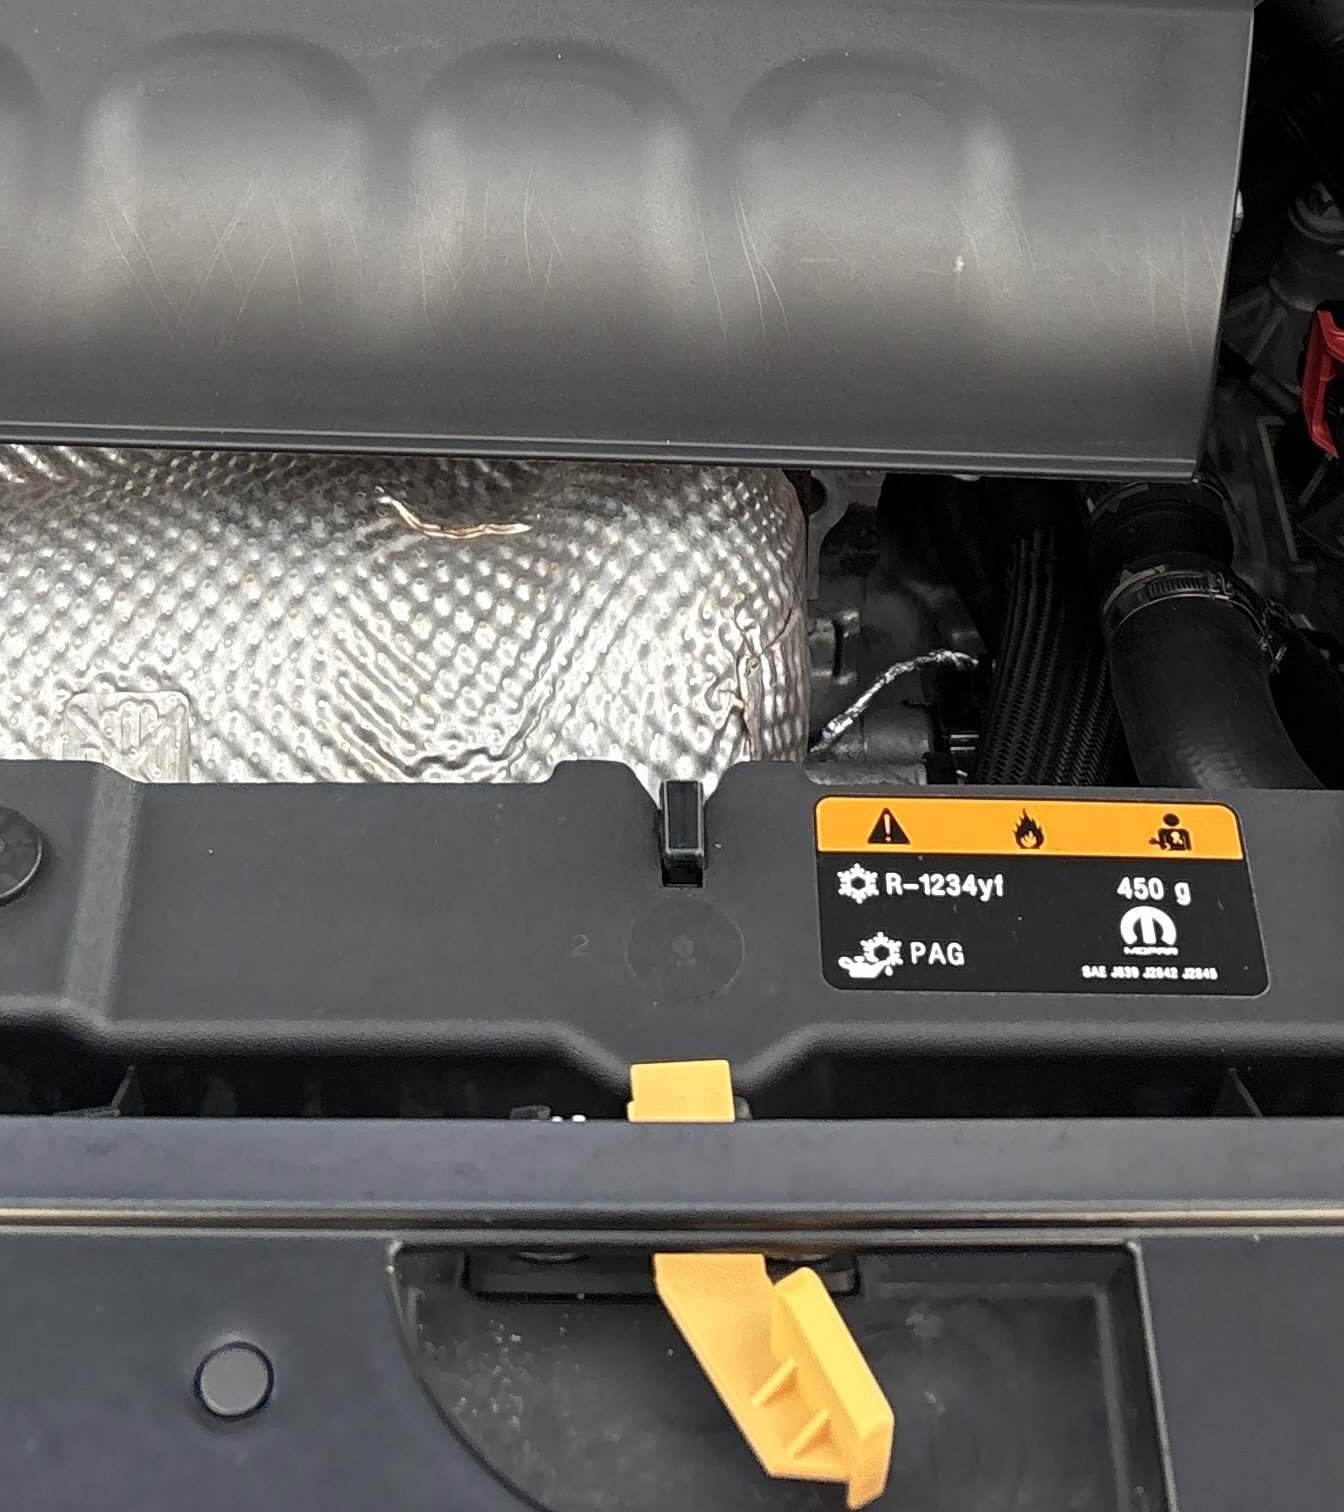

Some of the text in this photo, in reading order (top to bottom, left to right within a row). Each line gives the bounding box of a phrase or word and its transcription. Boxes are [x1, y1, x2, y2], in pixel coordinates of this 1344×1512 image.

[885, 872, 1192, 906] R-1234yf 450 g
[909, 941, 966, 966] PAG
[1082, 965, 1108, 978] SAE
